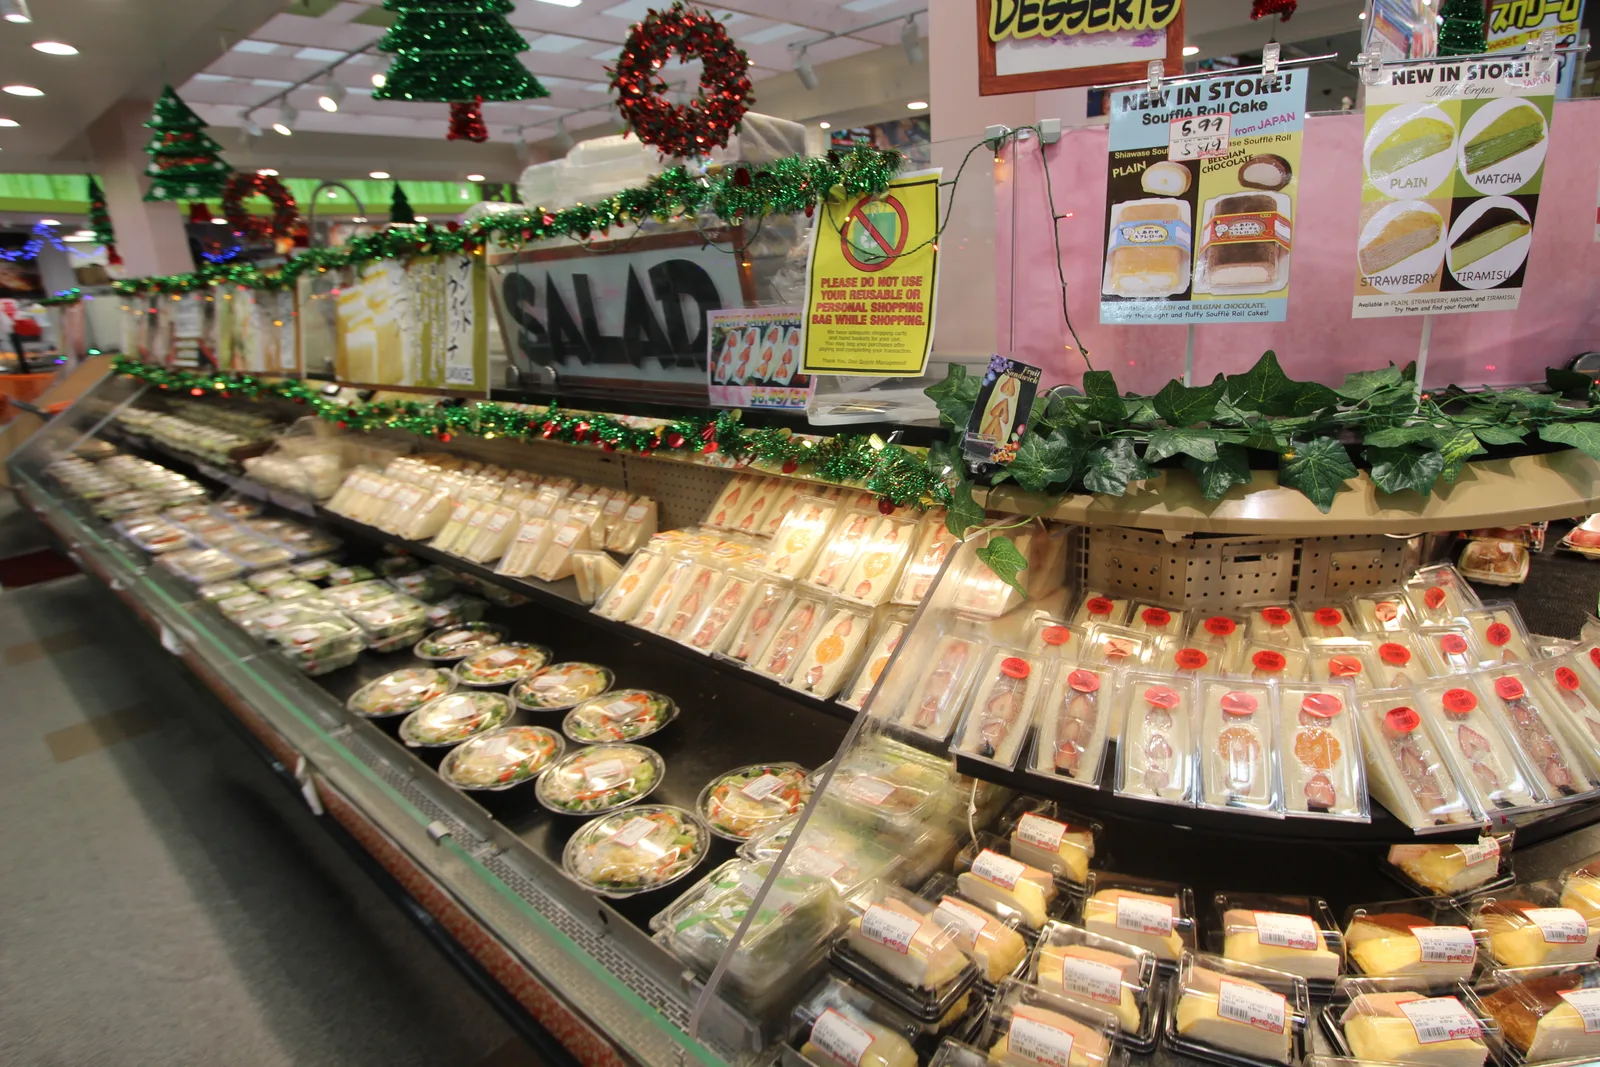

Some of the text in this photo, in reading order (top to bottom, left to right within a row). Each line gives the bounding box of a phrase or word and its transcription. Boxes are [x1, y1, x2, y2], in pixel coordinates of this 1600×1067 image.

[1487, 24, 1574, 50] weet Trts
[1392, 62, 1530, 85] NEW IN STORE!
[1122, 74, 1292, 112] NEW IN STORE!
[1142, 99, 1268, 125] Soufflé Roll Cake
[1181, 117, 1223, 137] 5.99
[1234, 112, 1296, 136] from JAPAN
[1244, 136, 1273, 146] Soufflé
[1275, 134, 1291, 142] Roll
[1115, 150, 1150, 159] Shiawase
[1112, 161, 1147, 178] PLAIN
[1202, 154, 1254, 173] CHOCOLATE
[1390, 177, 1427, 189] PLAIN
[1475, 173, 1522, 185] MATCHA
[821, 276, 922, 288] PLEASE DO NOT USE
[1360, 273, 1439, 287] STRAWBERRY
[1456, 270, 1511, 282] TIRAMISU
[821, 289, 920, 300] YOUR REUSABLE OR
[503, 259, 722, 369] SALAD
[816, 302, 923, 312] PERSONAL SHOPPING
[812, 314, 925, 326] BAG WHILE SHOPPING.
[1005, 369, 1038, 385] Sandwich
[1022, 366, 1040, 377] Fruit
